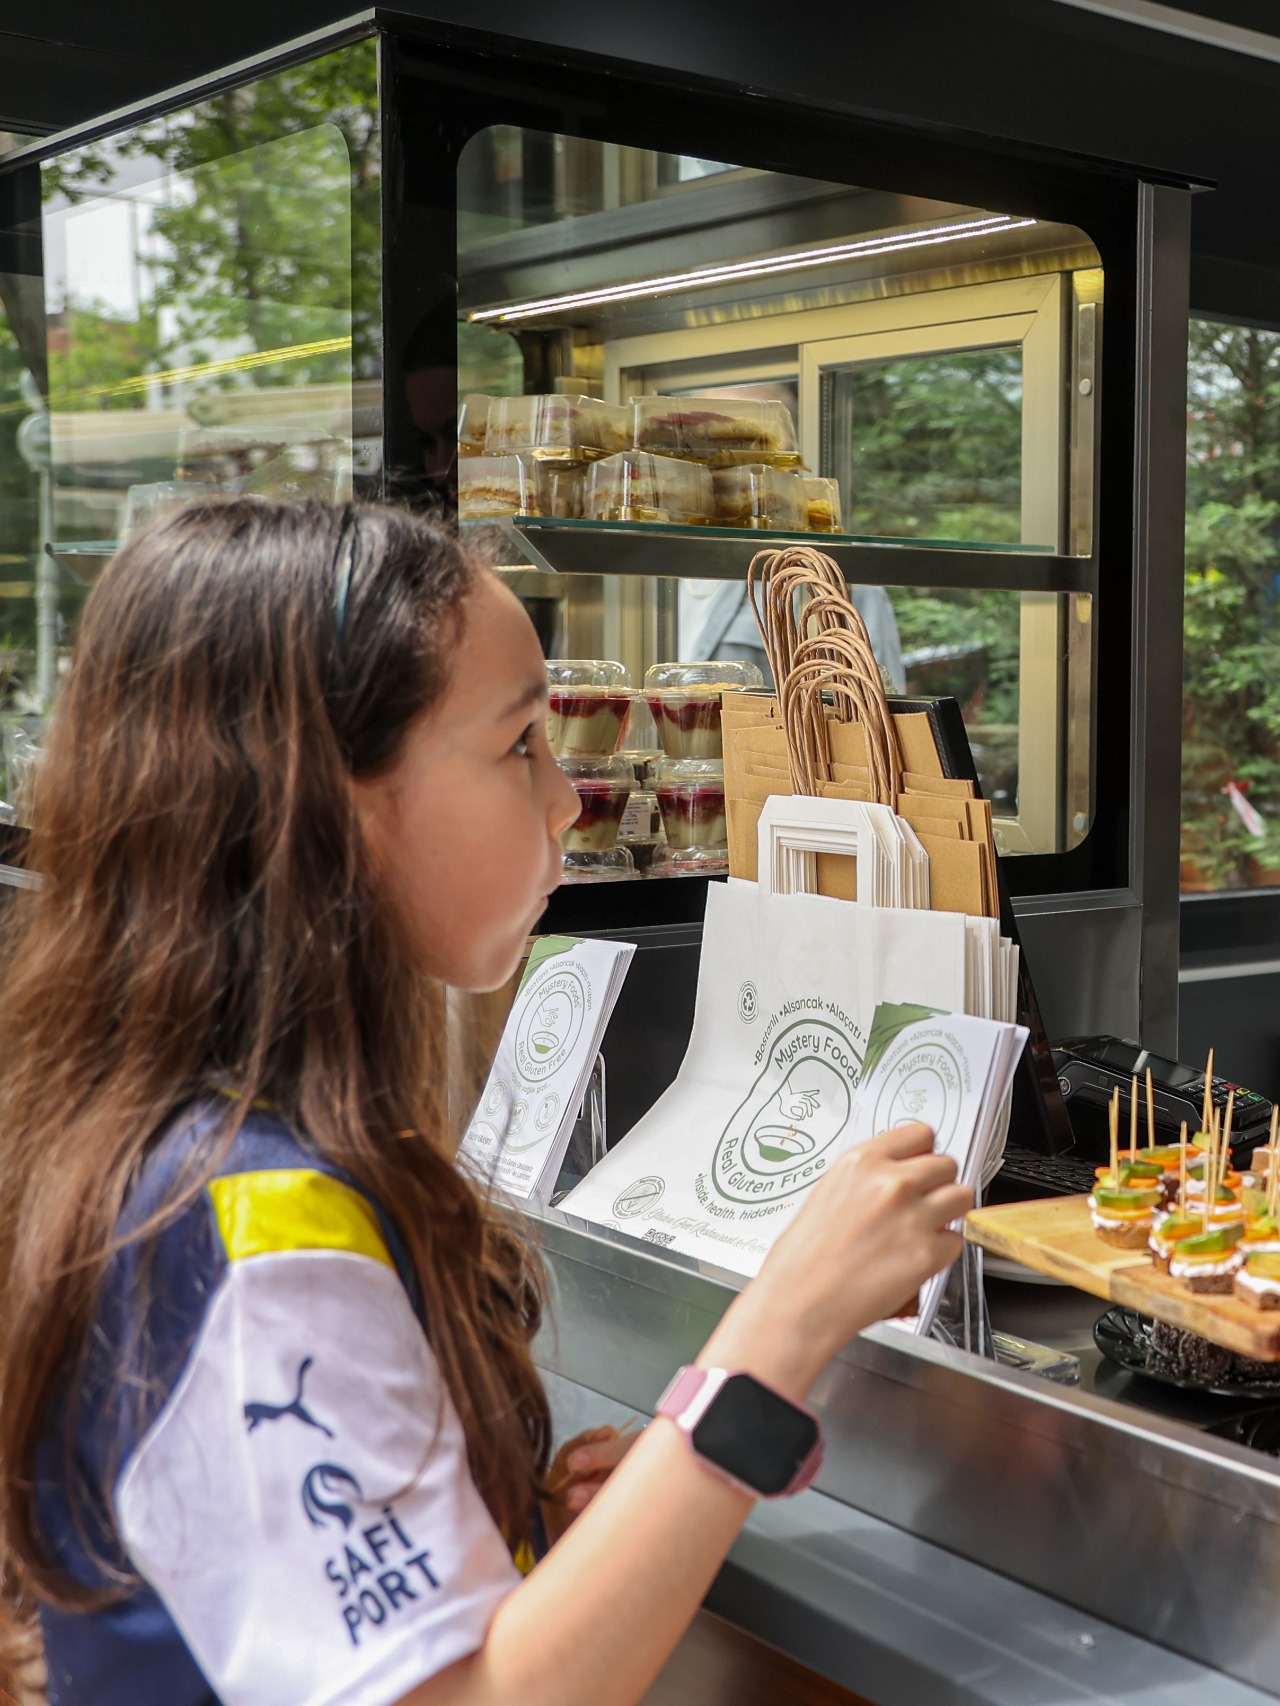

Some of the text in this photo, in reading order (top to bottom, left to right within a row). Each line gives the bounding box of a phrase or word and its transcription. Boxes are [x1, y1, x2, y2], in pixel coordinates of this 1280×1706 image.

[538, 979, 568, 999] Mystery
[755, 1014, 779, 1063] Bostanlı
[783, 996, 823, 1017] Alsancak
[829, 1002, 862, 1039] Alaçatı
[518, 1040, 566, 1076] Real Gluten Free
[774, 1034, 861, 1089] Mystery Foods
[898, 1052, 936, 1077] Mystery
[721, 1137, 827, 1193] Real Gluten Free
[342, 1551, 440, 1647] PORT
